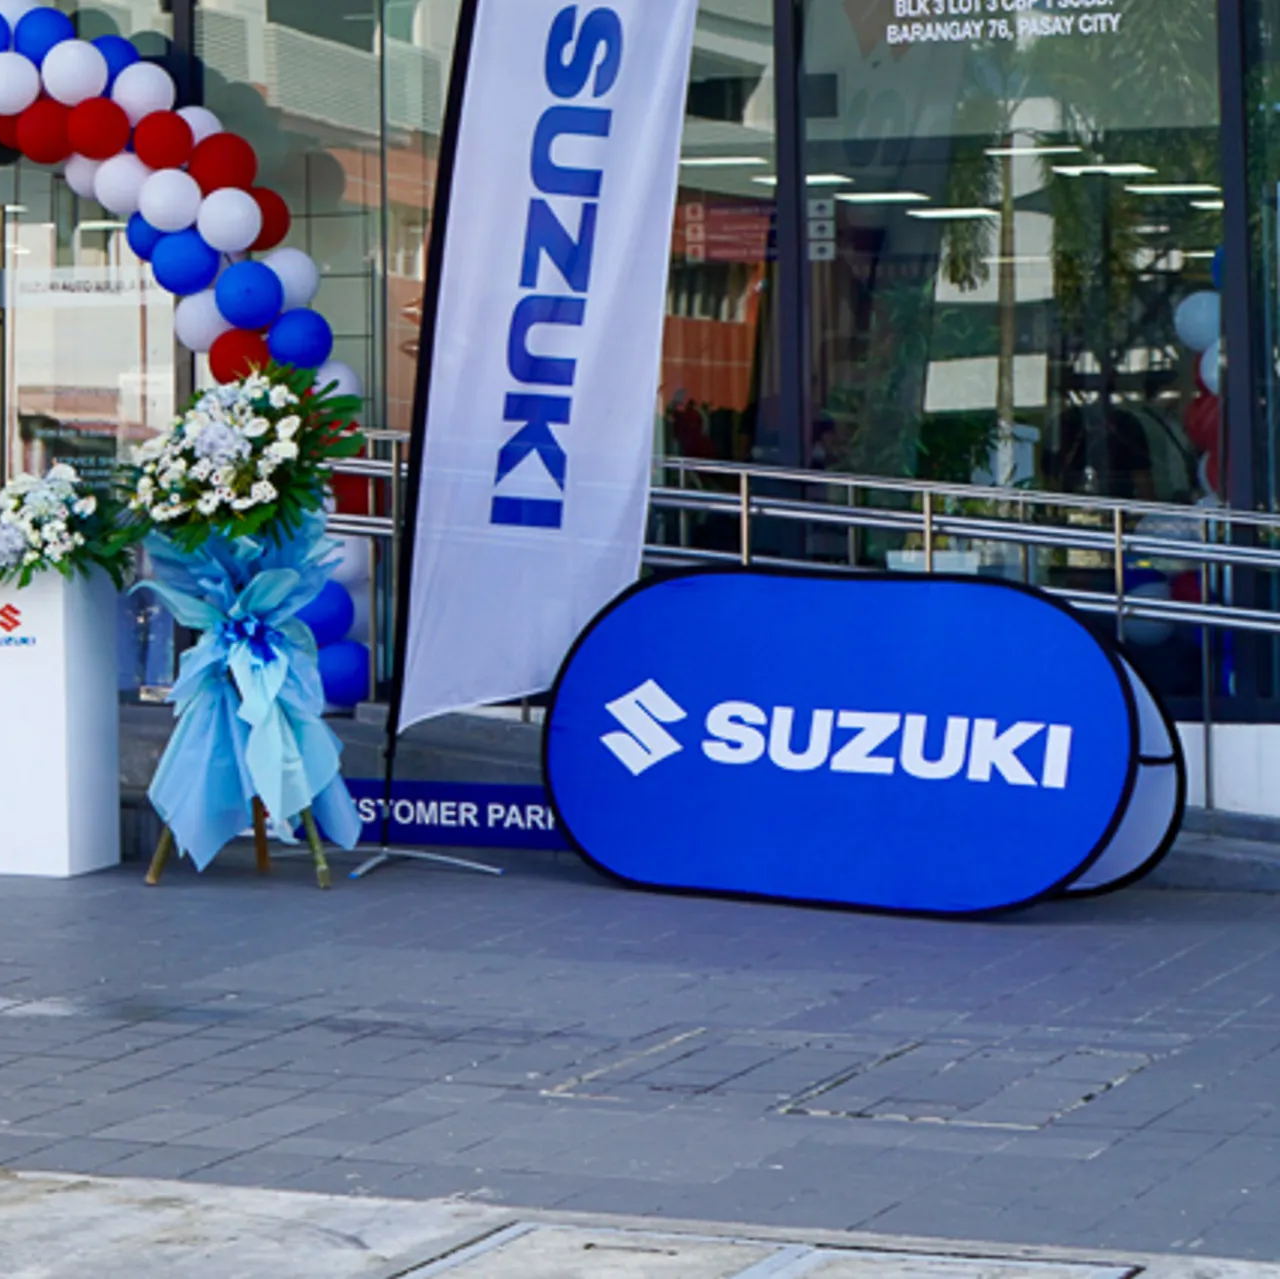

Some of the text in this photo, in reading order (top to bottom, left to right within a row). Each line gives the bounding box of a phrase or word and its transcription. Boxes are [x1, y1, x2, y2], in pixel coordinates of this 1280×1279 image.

[886, 20, 984, 44] BARANGAY
[1016, 16, 1075, 37] PASAY
[1078, 13, 1122, 33] CITY
[490, 4, 624, 529] SUZUKI
[701, 700, 1072, 789] SUZUKI
